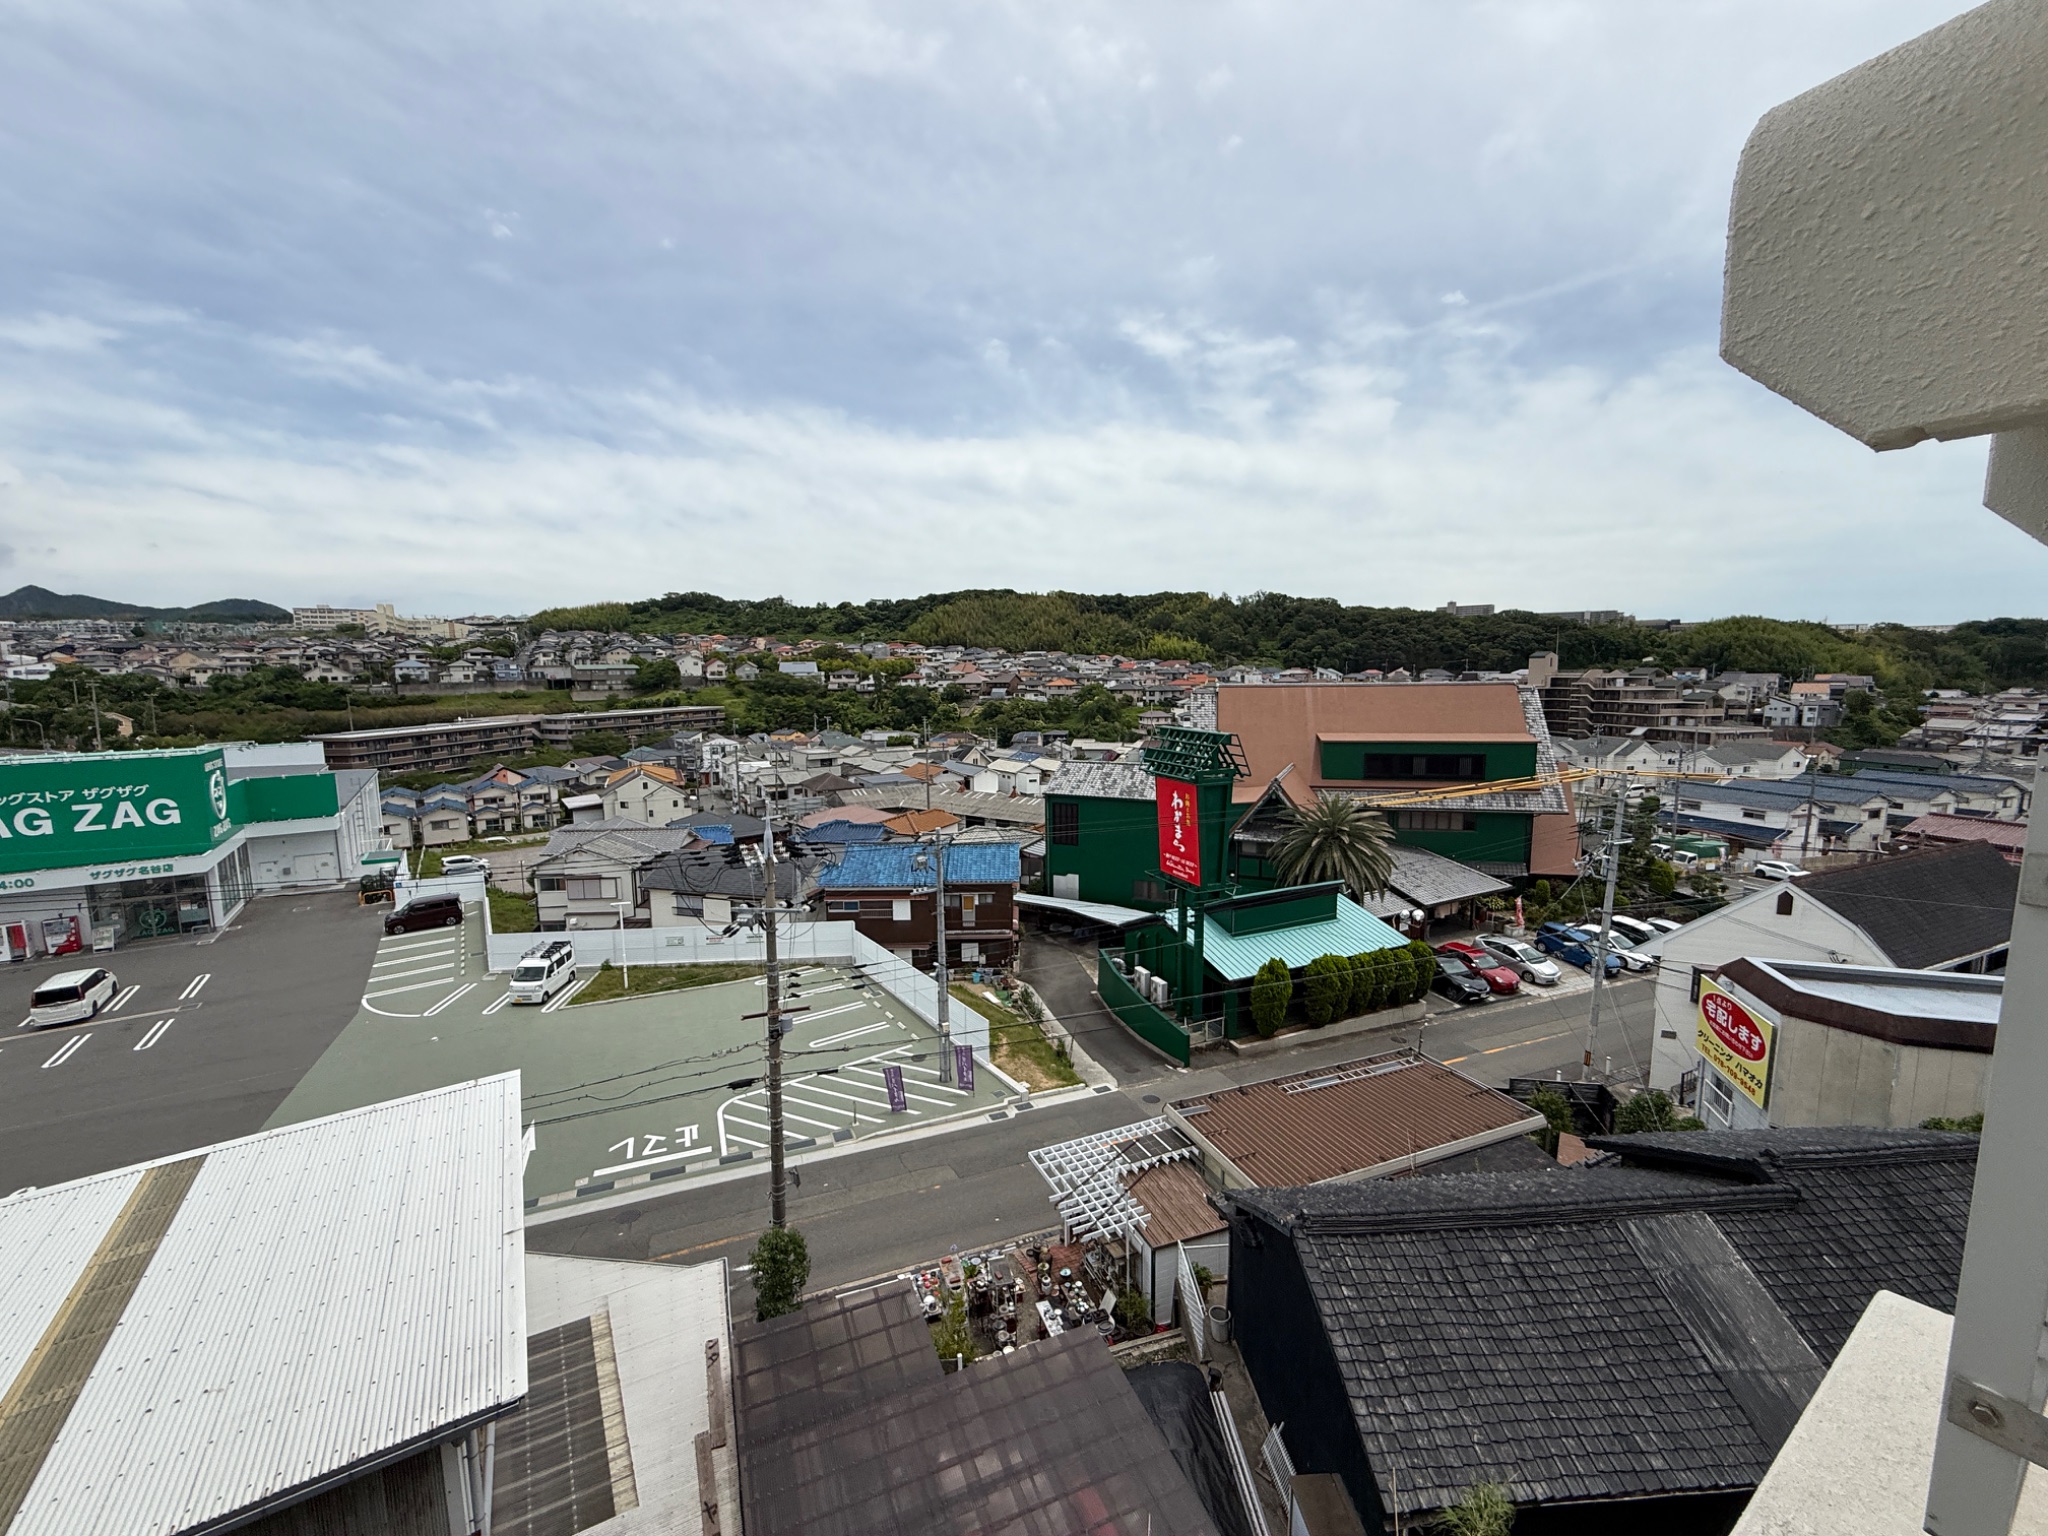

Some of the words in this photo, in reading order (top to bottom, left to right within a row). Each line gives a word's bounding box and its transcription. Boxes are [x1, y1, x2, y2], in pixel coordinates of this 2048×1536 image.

[82, 784, 149, 800] ザグザグ
[71, 798, 181, 832] ZAG
[89, 863, 174, 880] ザグザグ名谷店
[1705, 999, 1763, 1051] 宅配します
[1697, 1029, 1733, 1062] クリーニング
[1734, 1061, 1763, 1089] ハマオカ
[608, 1123, 699, 1160] 止マレ
